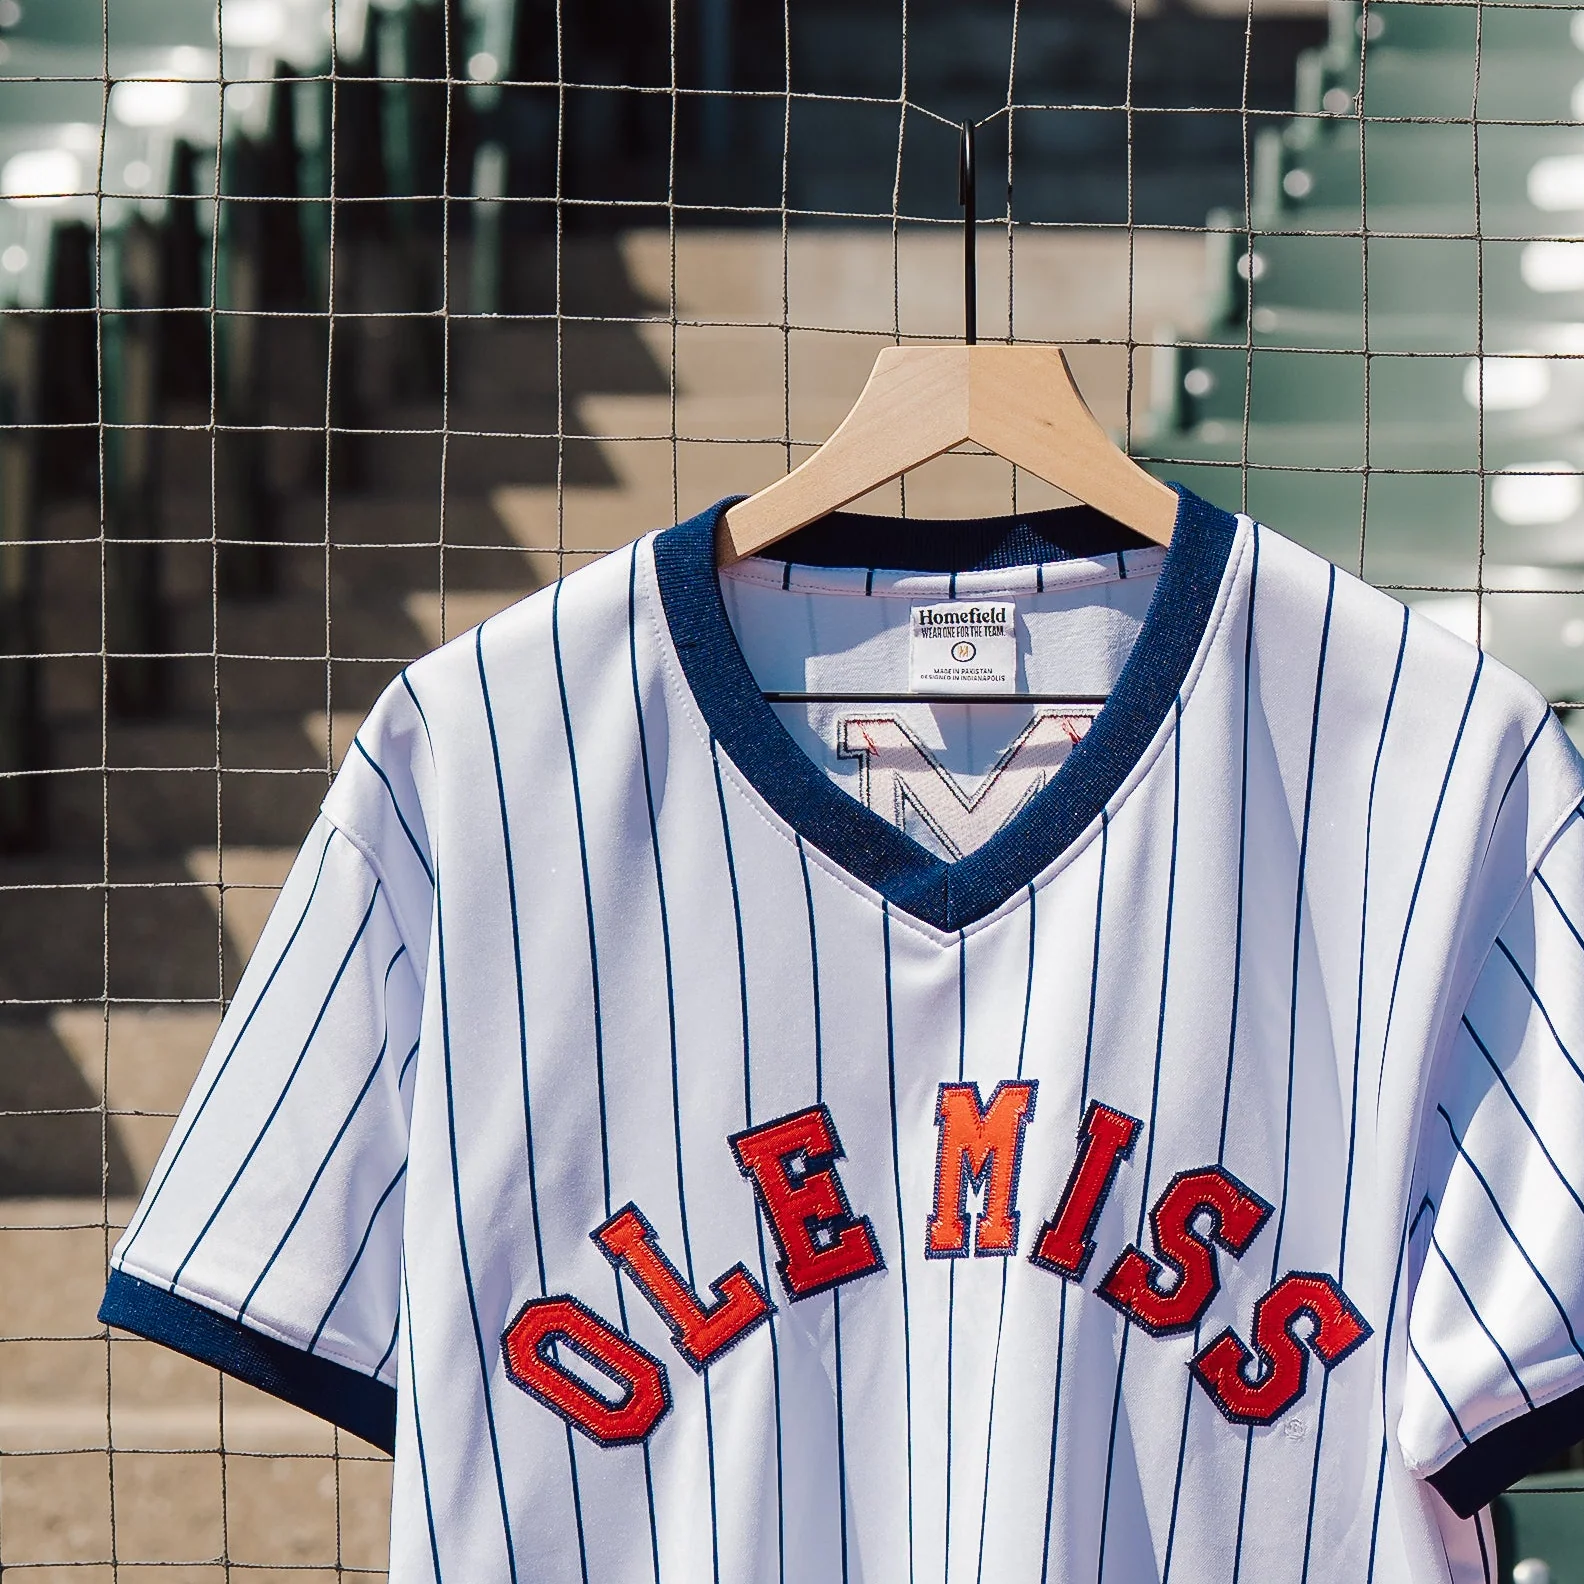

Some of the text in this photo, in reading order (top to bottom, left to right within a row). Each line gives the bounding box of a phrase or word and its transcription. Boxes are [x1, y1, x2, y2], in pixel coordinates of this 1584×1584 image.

[919, 607, 1006, 625] Homefield
[921, 625, 1006, 639] WEAR ONE FOR THE TEAM.
[499, 1079, 1375, 1450] OLE MISS
